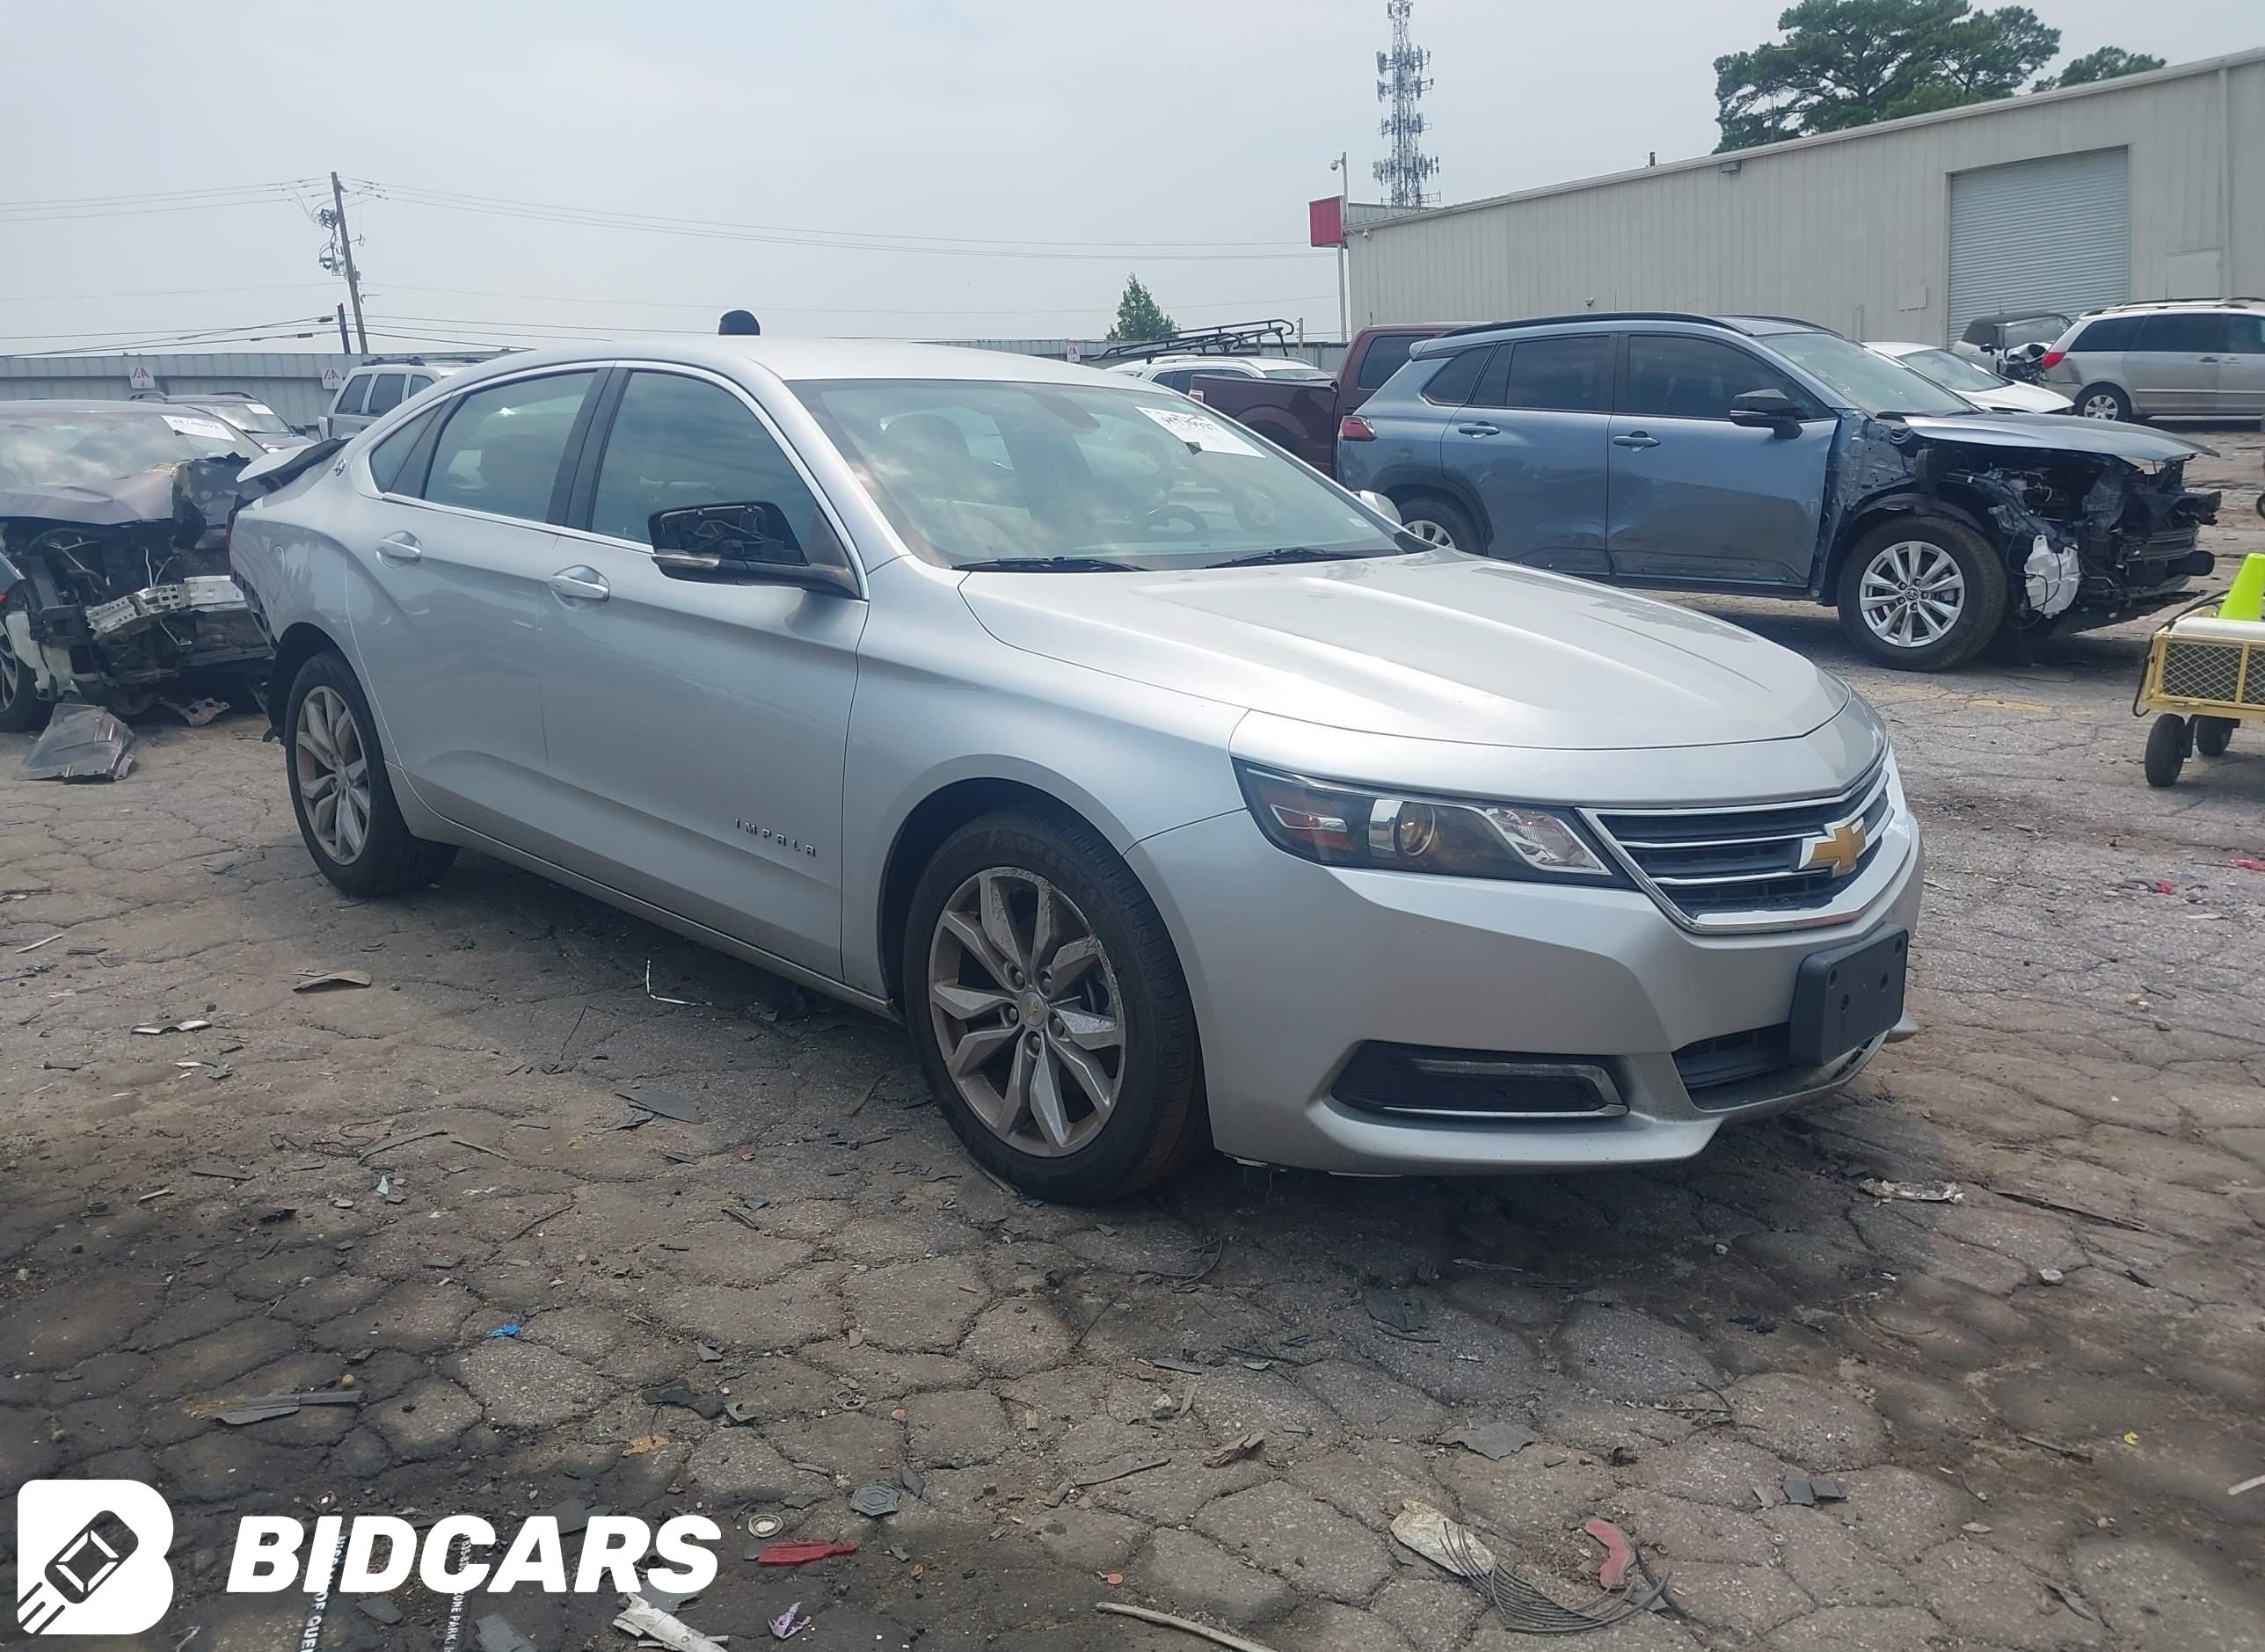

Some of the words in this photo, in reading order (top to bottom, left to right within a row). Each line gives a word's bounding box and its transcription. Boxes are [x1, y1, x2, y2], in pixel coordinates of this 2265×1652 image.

[734, 817, 816, 858] IMPALA
[312, 1591, 329, 1611] OF
[300, 1615, 322, 1652] QUE
